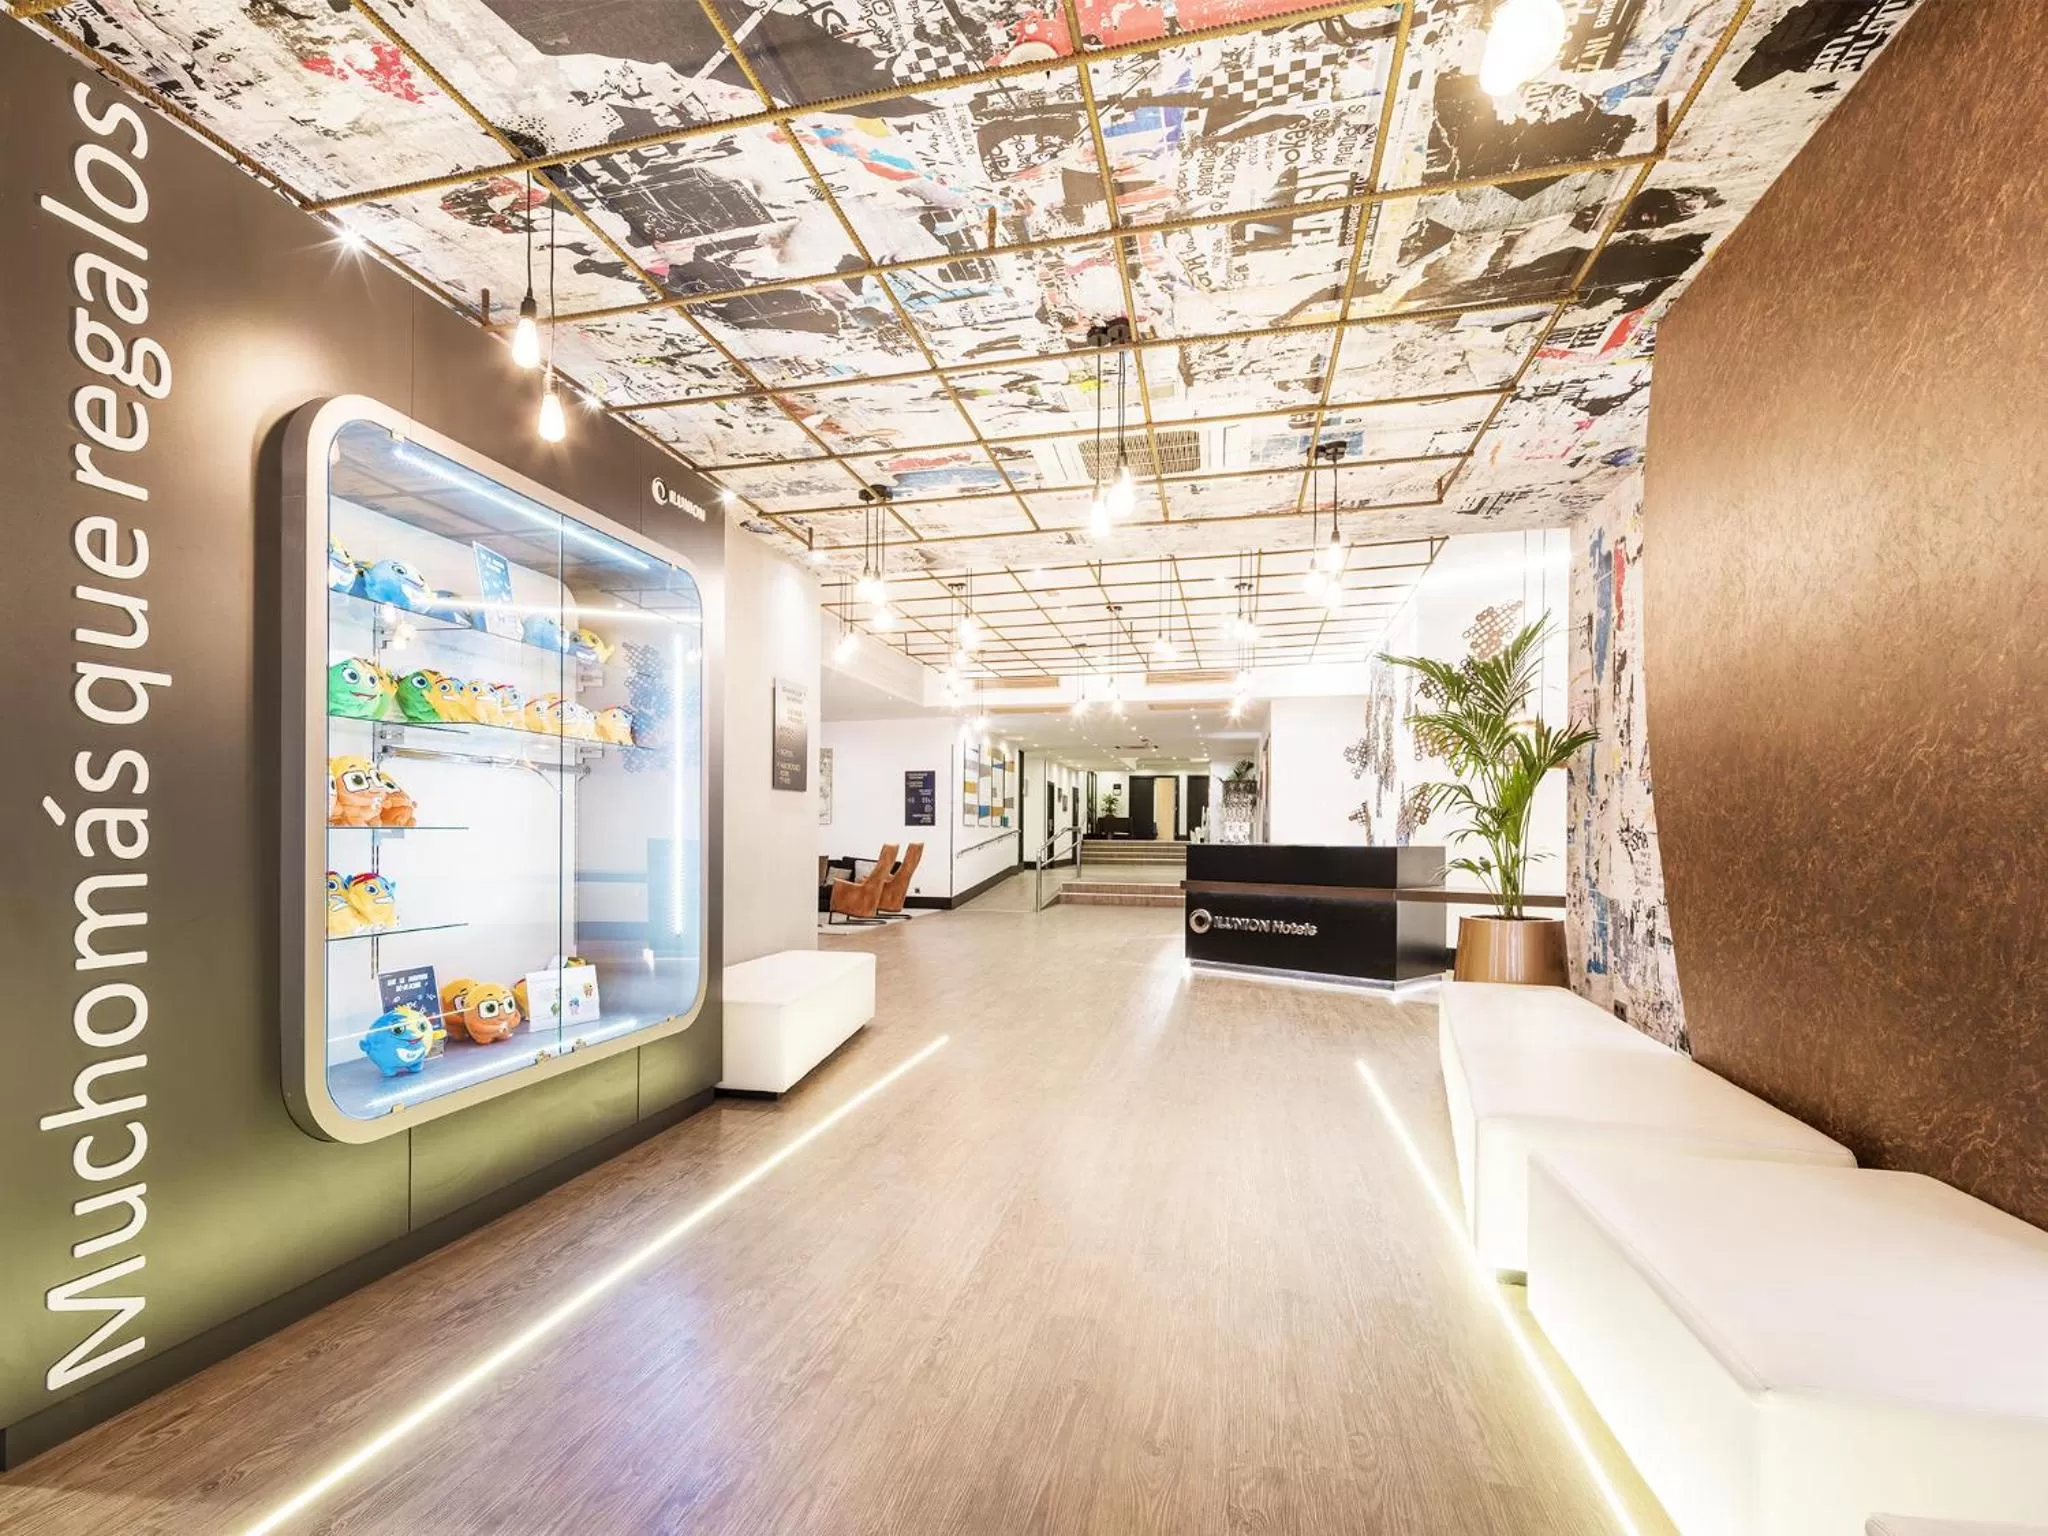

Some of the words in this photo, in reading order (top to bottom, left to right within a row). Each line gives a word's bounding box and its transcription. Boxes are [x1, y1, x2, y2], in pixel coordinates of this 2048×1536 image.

[40, 82, 172, 501] regalos
[75, 517, 172, 724] que
[1272, 920, 1318, 937] Hotels
